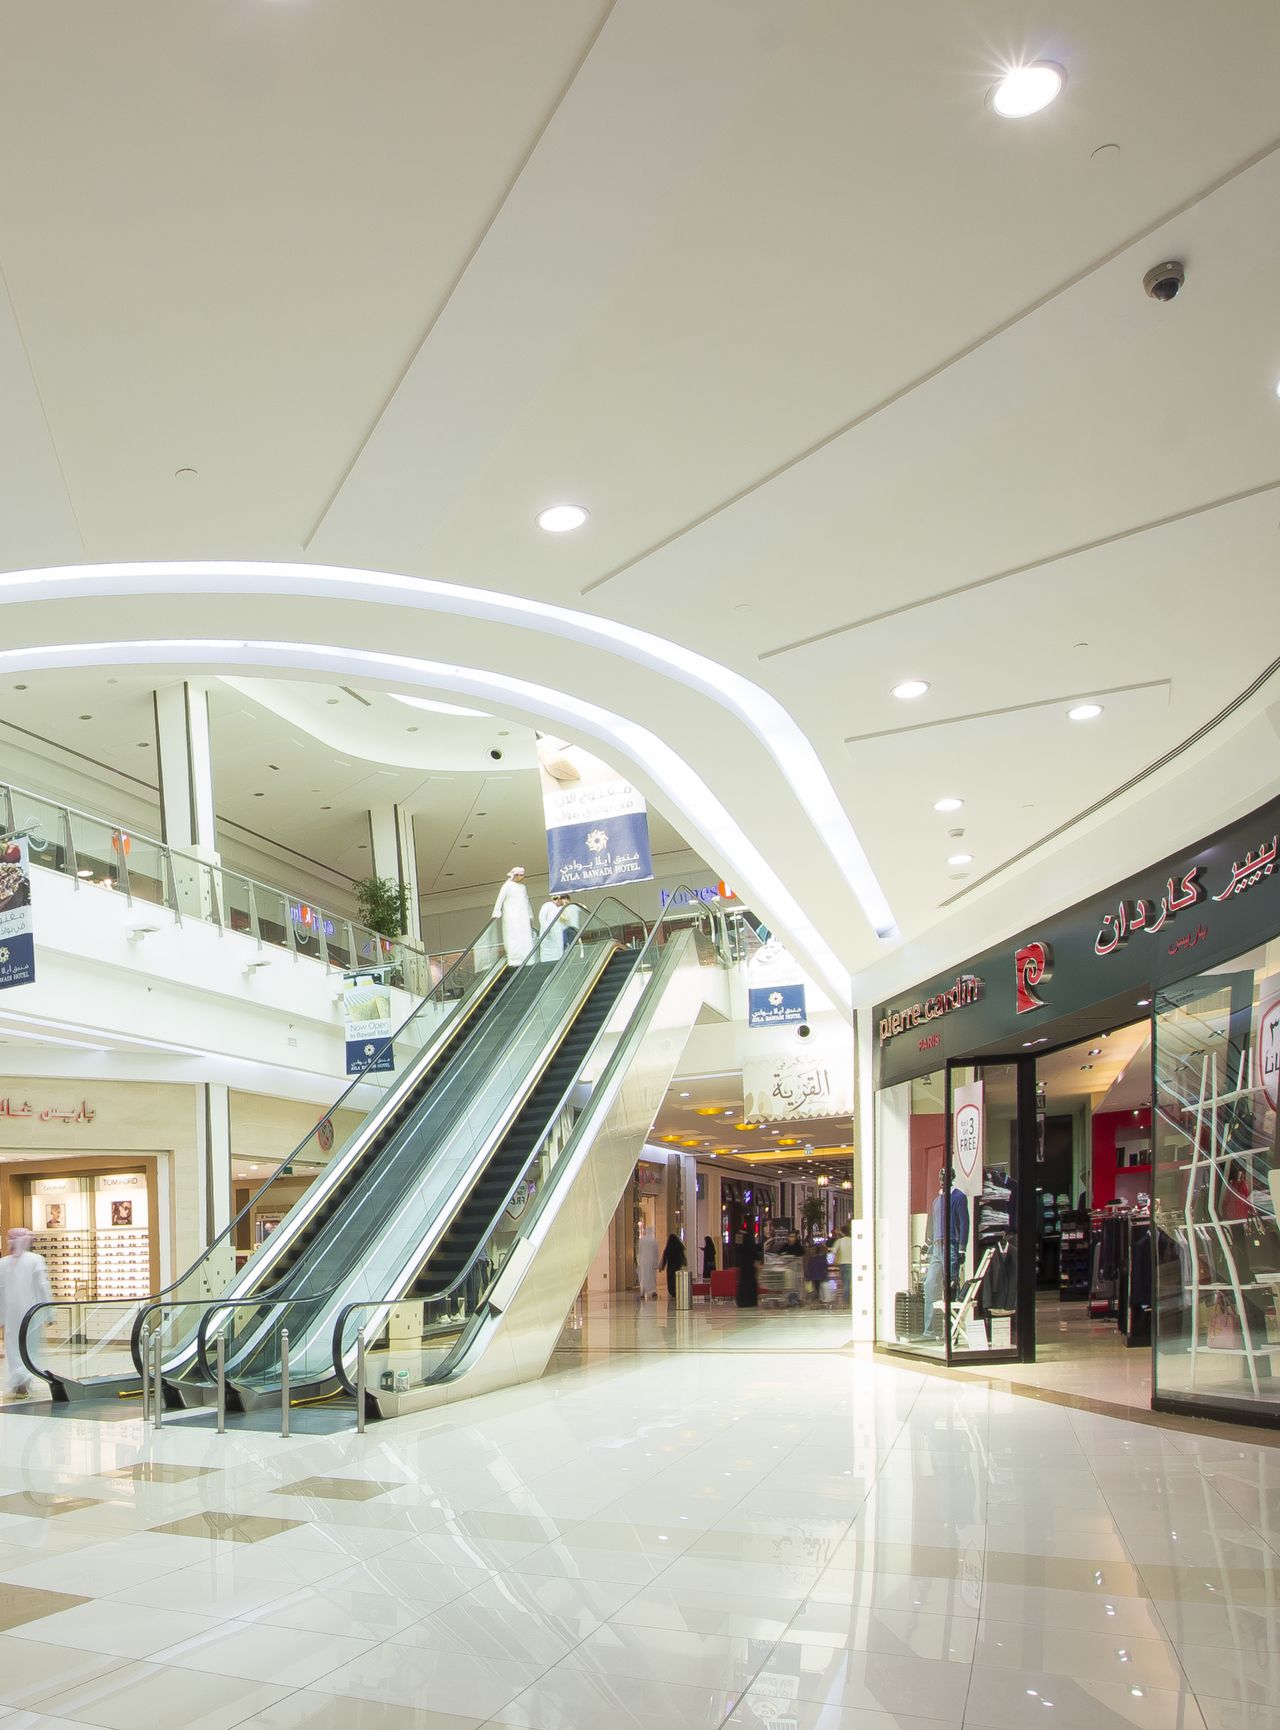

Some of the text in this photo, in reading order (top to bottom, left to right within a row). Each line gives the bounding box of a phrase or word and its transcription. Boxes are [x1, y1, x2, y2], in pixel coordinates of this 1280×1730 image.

[560, 862, 641, 883] AYLA BAWADI HOTEL
[1095, 867, 1198, 956] كاردان
[13, 971, 30, 980] HOTEL
[880, 977, 978, 1047] pierre cardin
[351, 1022, 389, 1032] Now Open
[918, 1032, 941, 1052] PARIS
[39, 1100, 96, 1123] باريس
[969, 1117, 975, 1135] 3
[960, 1136, 976, 1151] FREE
[103, 1177, 138, 1186] TOM FORD
